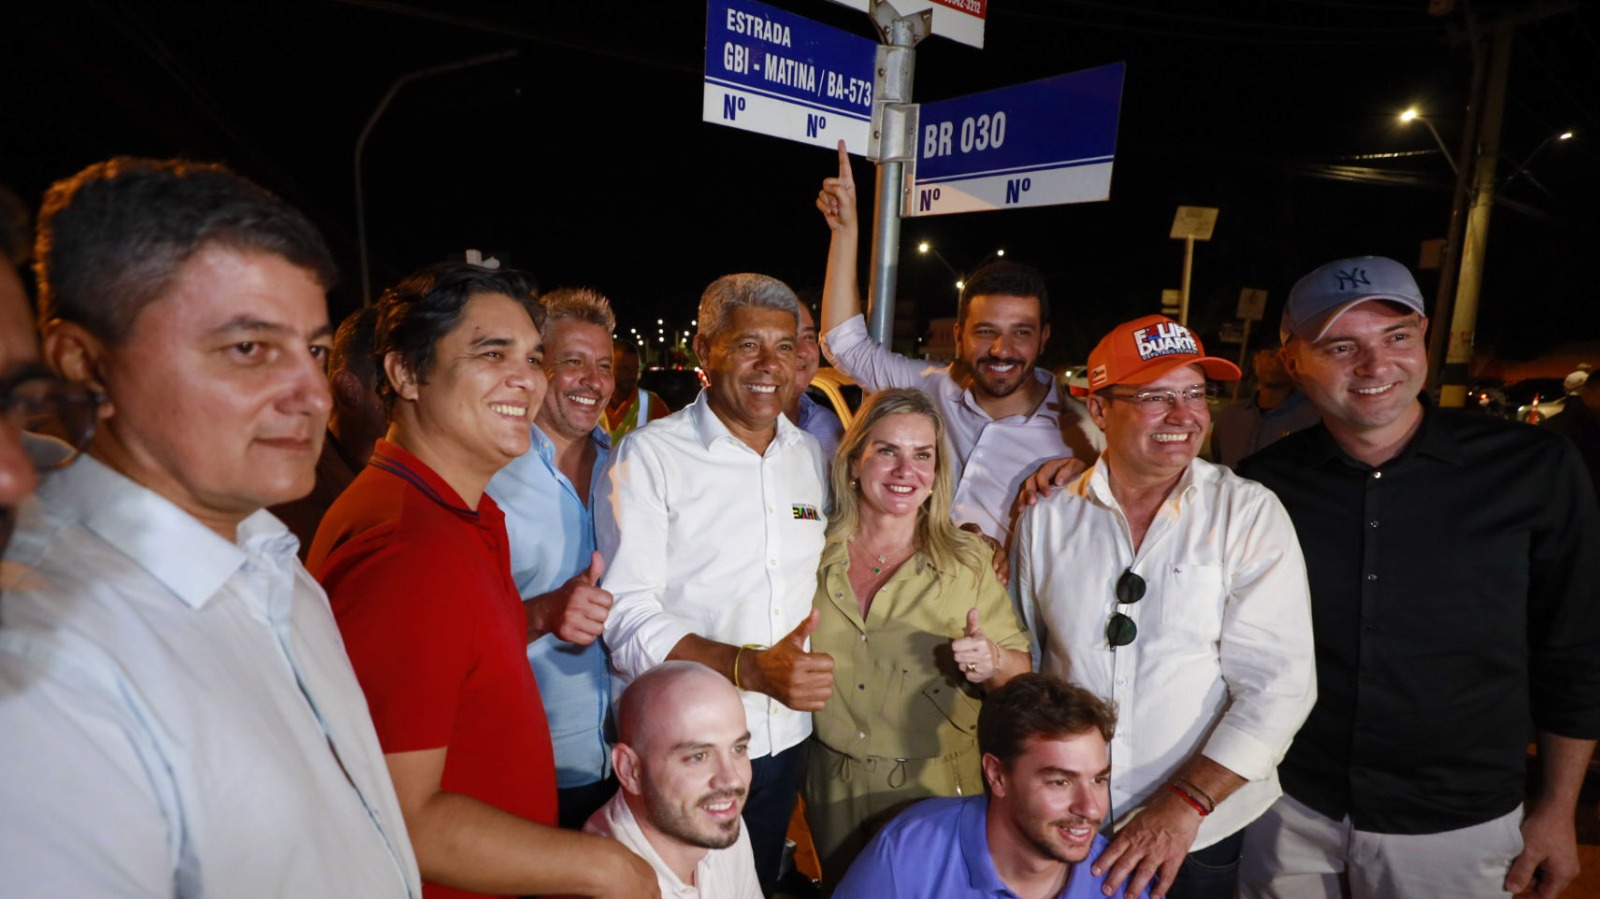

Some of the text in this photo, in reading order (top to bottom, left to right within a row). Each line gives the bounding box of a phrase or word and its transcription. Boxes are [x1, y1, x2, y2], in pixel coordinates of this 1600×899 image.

[727, 8, 791, 48] ESTRADA
[723, 42, 749, 75] GBI
[764, 53, 816, 92] MATINA
[827, 71, 872, 107] BA-573
[923, 111, 1006, 159] BR 030
[1139, 336, 1198, 356] DUARTE
